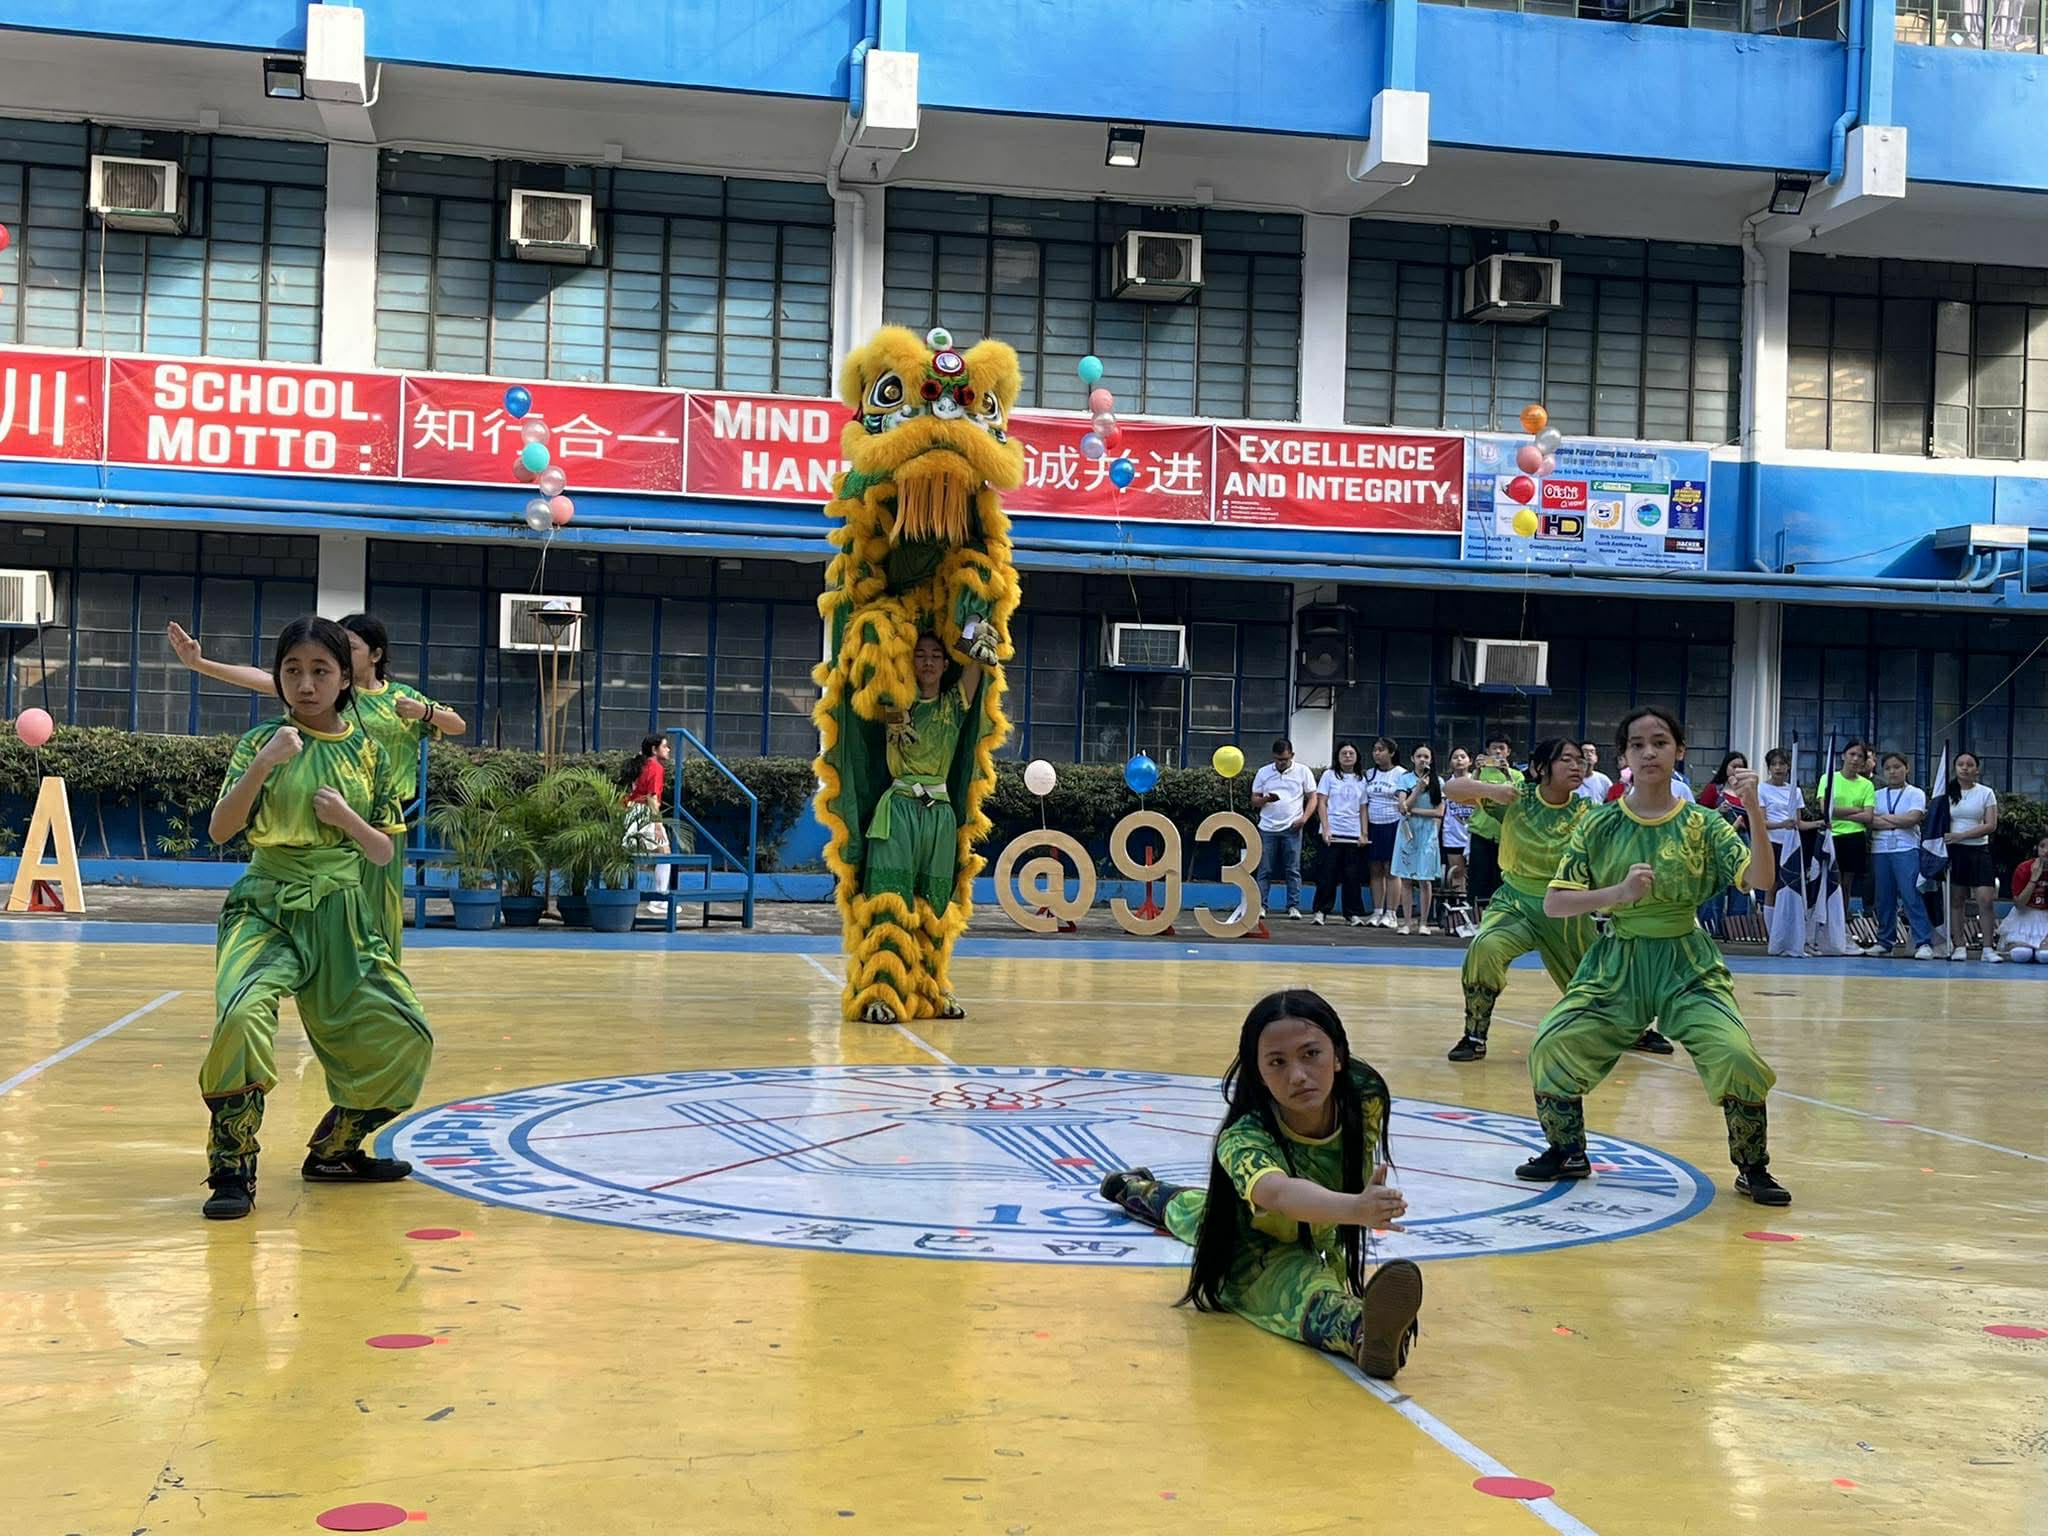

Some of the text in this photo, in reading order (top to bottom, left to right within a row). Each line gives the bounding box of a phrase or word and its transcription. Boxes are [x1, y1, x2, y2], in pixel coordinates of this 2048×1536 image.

[154, 364, 368, 421] SCHOOL
[147, 415, 336, 470] MOTTO
[413, 403, 680, 460] 知行合一
[714, 400, 829, 443] MIND
[742, 451, 853, 493] HAN
[1239, 435, 1436, 471] EXCELLENCE
[1223, 472, 1286, 498] AND
[1544, 484, 1578, 499] Oishi
[7, 776, 86, 913] A
[562, 1069, 813, 1095] PASAY
[844, 1067, 1171, 1082] CHUNG
